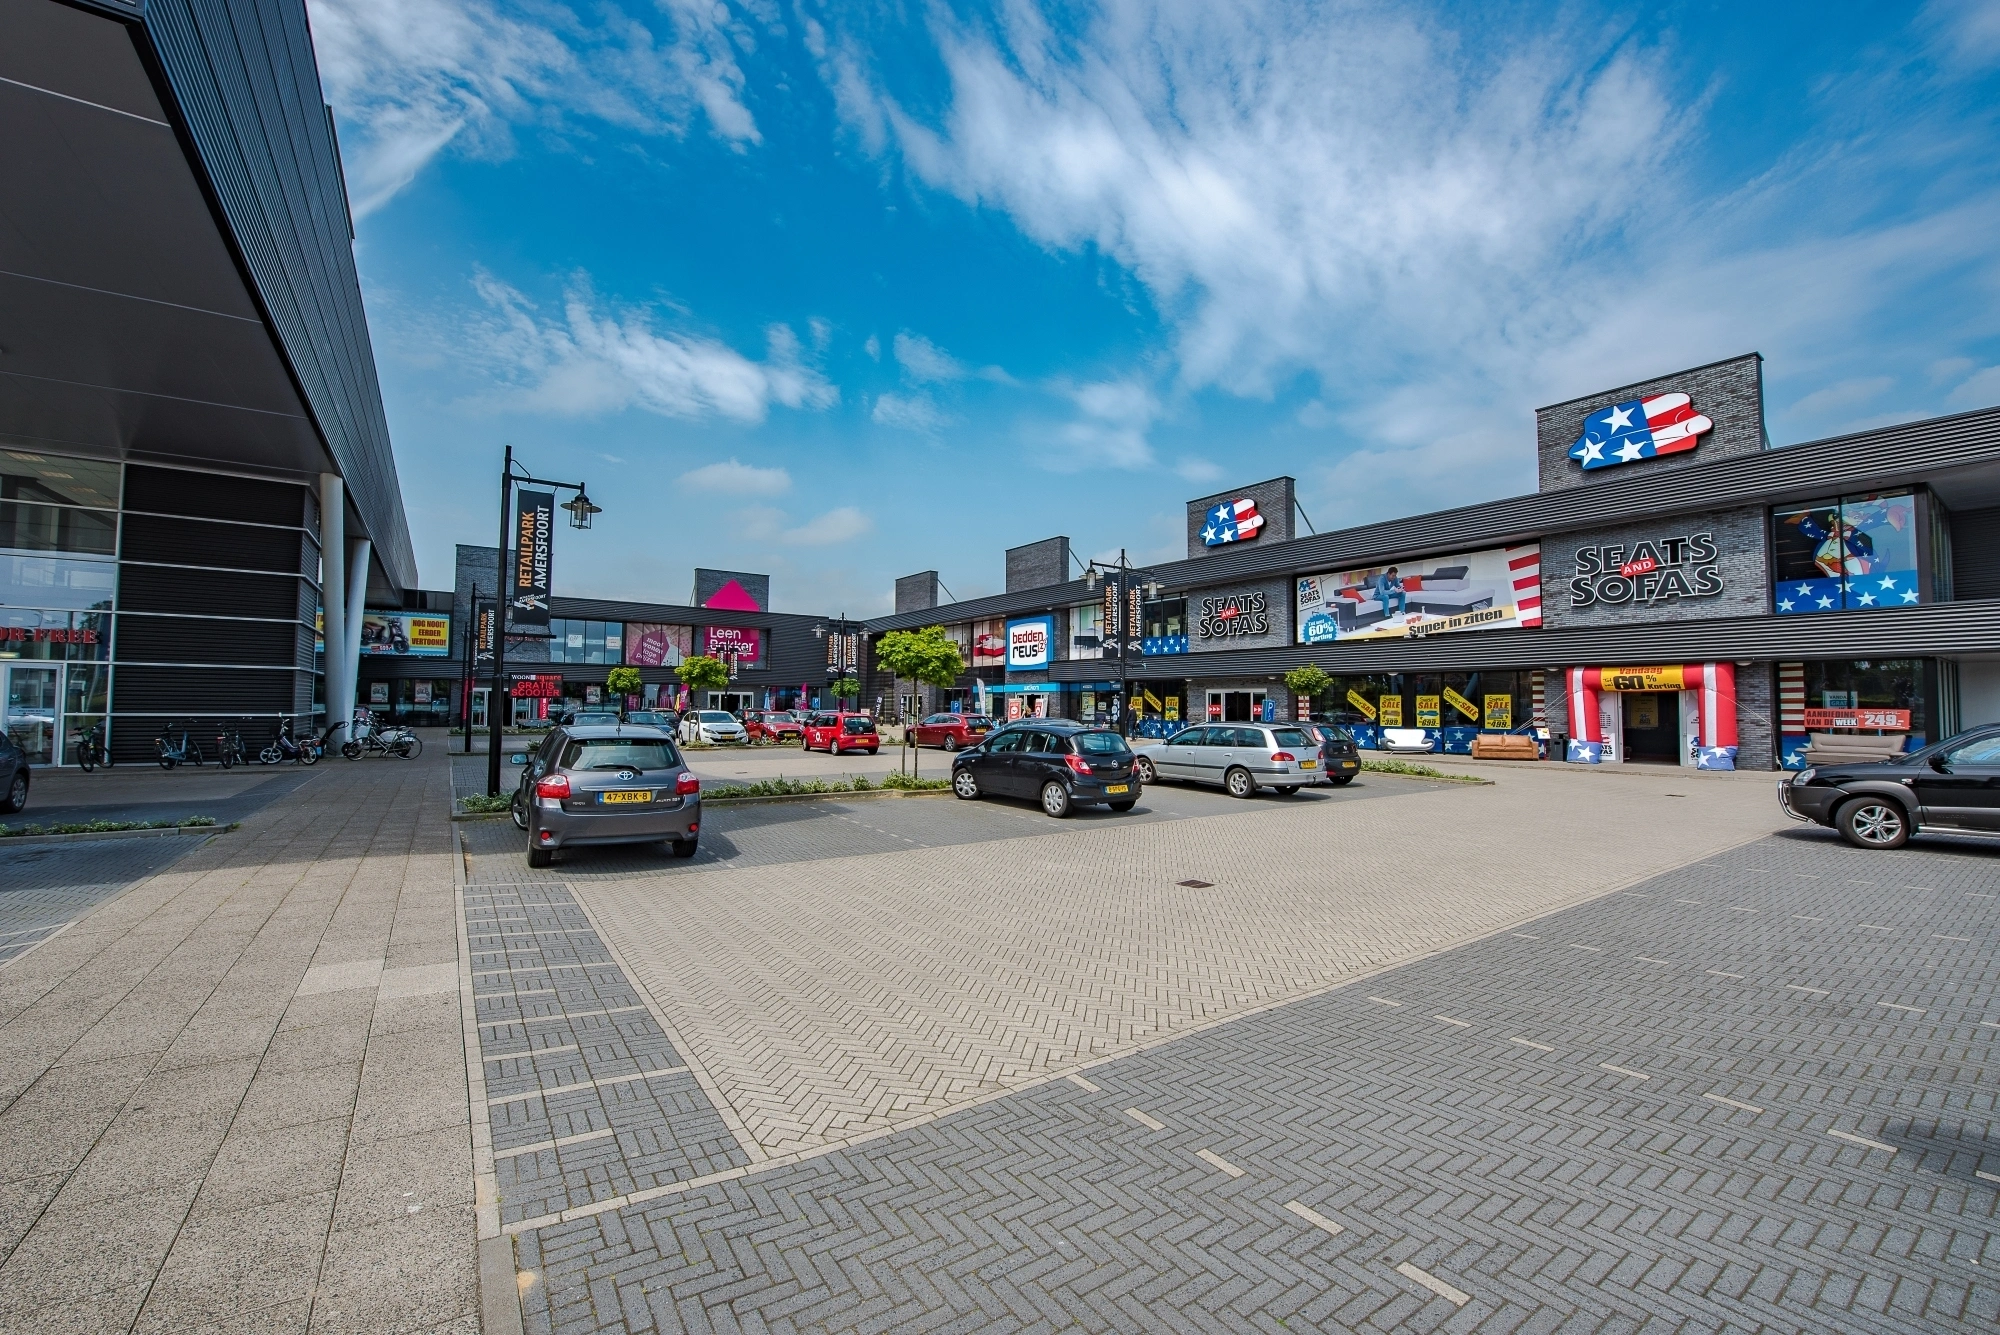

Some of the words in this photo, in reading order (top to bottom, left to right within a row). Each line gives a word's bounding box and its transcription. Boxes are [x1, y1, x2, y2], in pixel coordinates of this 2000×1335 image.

[519, 512, 534, 587] RETAILPARK
[534, 505, 550, 589] AMERSFOORT
[1576, 532, 1717, 576] SEATS
[1624, 560, 1652, 575] AND
[1570, 565, 1724, 606] SOFAS
[1300, 589, 1320, 600] SEATS
[1300, 595, 1320, 605] SOFAS
[1202, 592, 1265, 618] SEATS
[1222, 609, 1235, 618] AND
[426, 620, 446, 628] NOOIT
[1199, 613, 1268, 638] SOFAS
[1408, 620, 1446, 635] Super
[1449, 618, 1462, 628] in
[1464, 610, 1502, 624] zitten
[33, 628, 98, 644] FREE
[710, 627, 741, 640] Leen
[518, 682, 554, 690] GRATIS
[1613, 676, 1646, 690] 60
[1360, 703, 1376, 716] SALE
[1460, 702, 1478, 716] SALE
[1806, 718, 1822, 726] VAN
[1835, 718, 1858, 726] WEEK
[606, 792, 648, 801] 47-XBK-8
